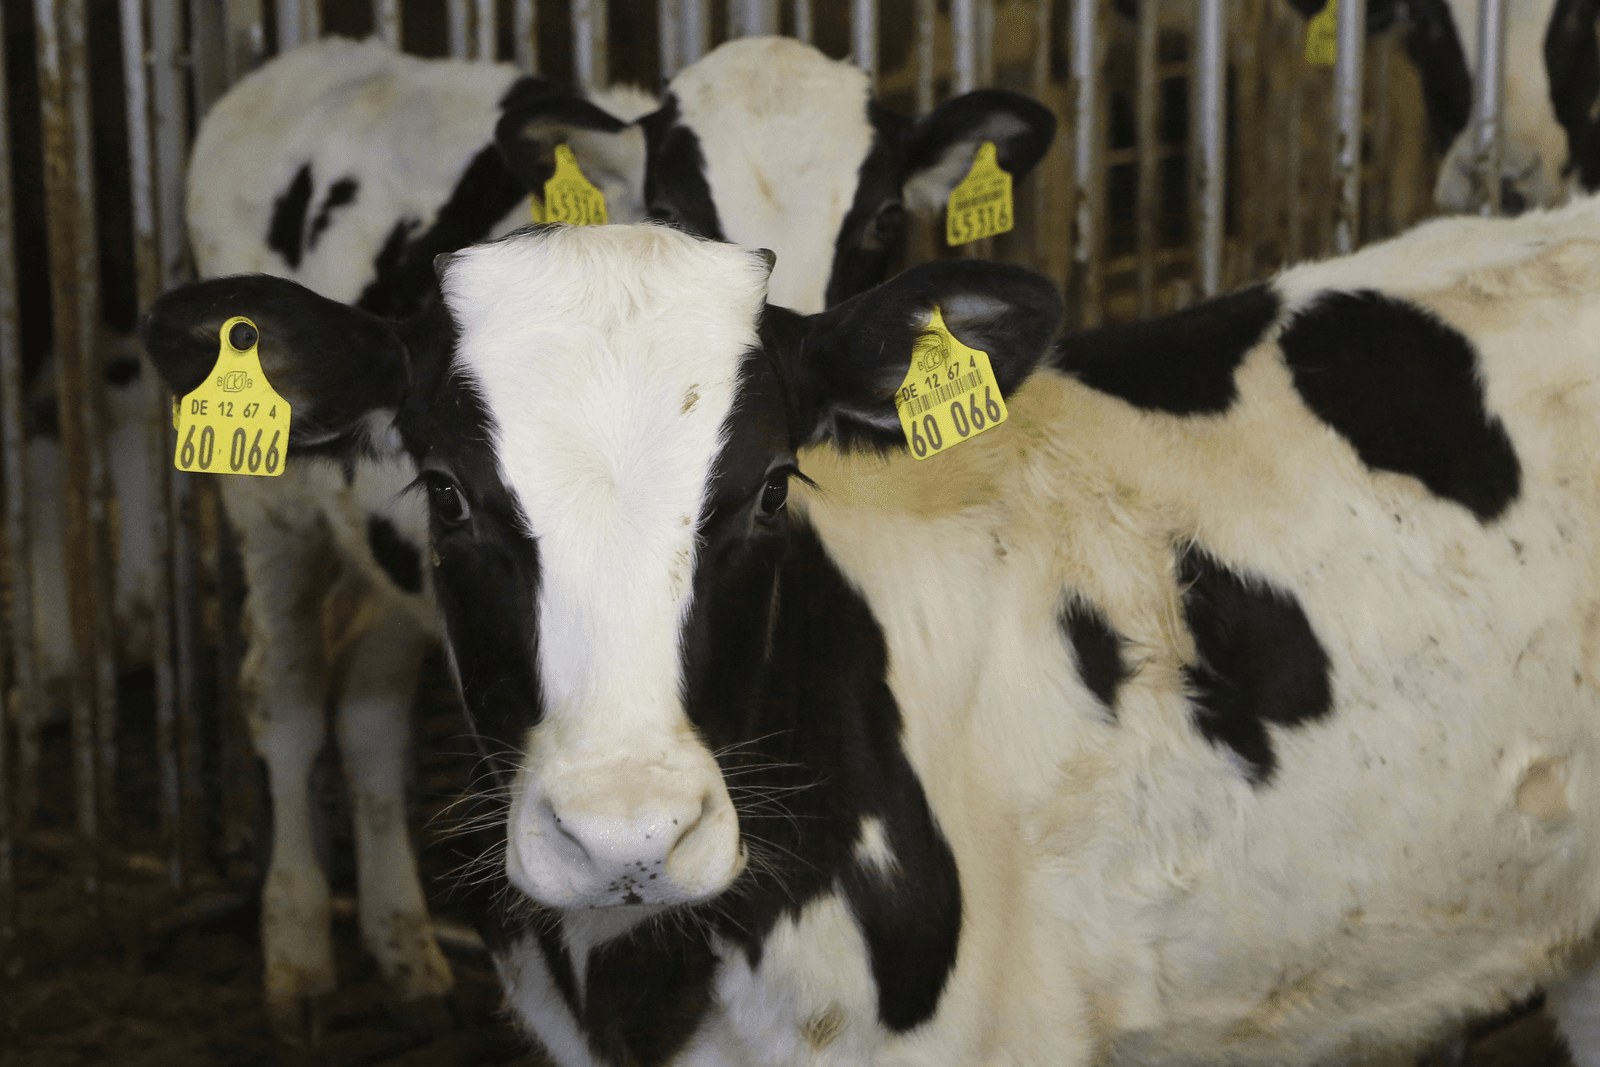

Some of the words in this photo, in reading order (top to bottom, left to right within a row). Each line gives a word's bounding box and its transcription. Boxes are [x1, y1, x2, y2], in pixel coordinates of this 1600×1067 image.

[901, 383, 918, 401] DE
[925, 373, 940, 389] 12
[947, 361, 960, 380] 67
[969, 355, 976, 368] 4
[191, 399, 208, 416] DE
[218, 401, 234, 418] 12
[243, 403, 260, 418] 67
[268, 404, 277, 420] 4
[911, 413, 943, 458] 60
[950, 385, 1001, 438] 066
[180, 424, 215, 470] 60
[229, 427, 281, 474] 066
